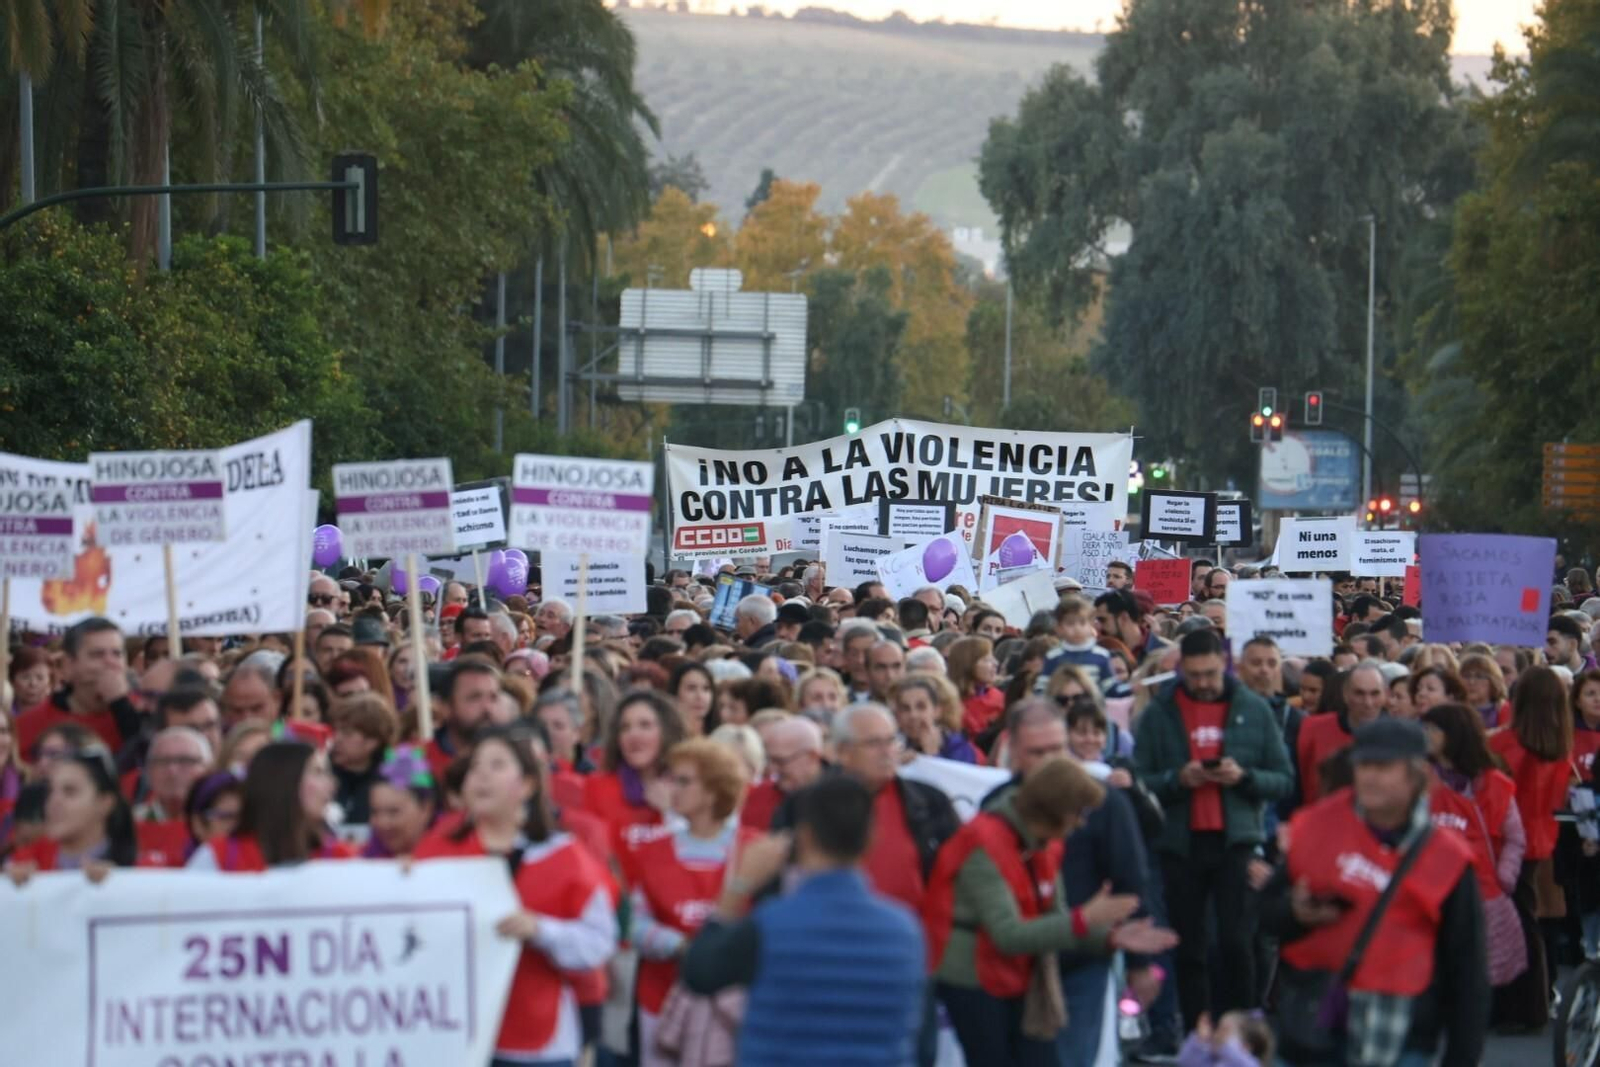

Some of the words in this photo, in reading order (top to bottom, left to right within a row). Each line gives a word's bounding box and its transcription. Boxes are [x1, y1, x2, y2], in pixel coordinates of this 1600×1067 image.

[782, 456, 809, 481] A
[821, 438, 871, 474] LA
[880, 431, 1097, 477] VIOLENCIA
[96, 457, 216, 479] HINOJOSA
[340, 467, 443, 490] HINOJOSA
[520, 462, 645, 489] HINOJOSA
[125, 484, 190, 501] CONTRA
[680, 480, 832, 521] CONTRA
[841, 468, 910, 506] LAS
[126, 505, 220, 522] VIOLENCIA
[544, 513, 643, 530] VIOLENCIA
[1299, 531, 1312, 542] Ni
[1313, 532, 1337, 541] una
[1297, 550, 1338, 559] menos
[183, 932, 292, 980] 25N
[307, 912, 384, 977] DÍA
[104, 986, 462, 1044] INTERNACIONAL
